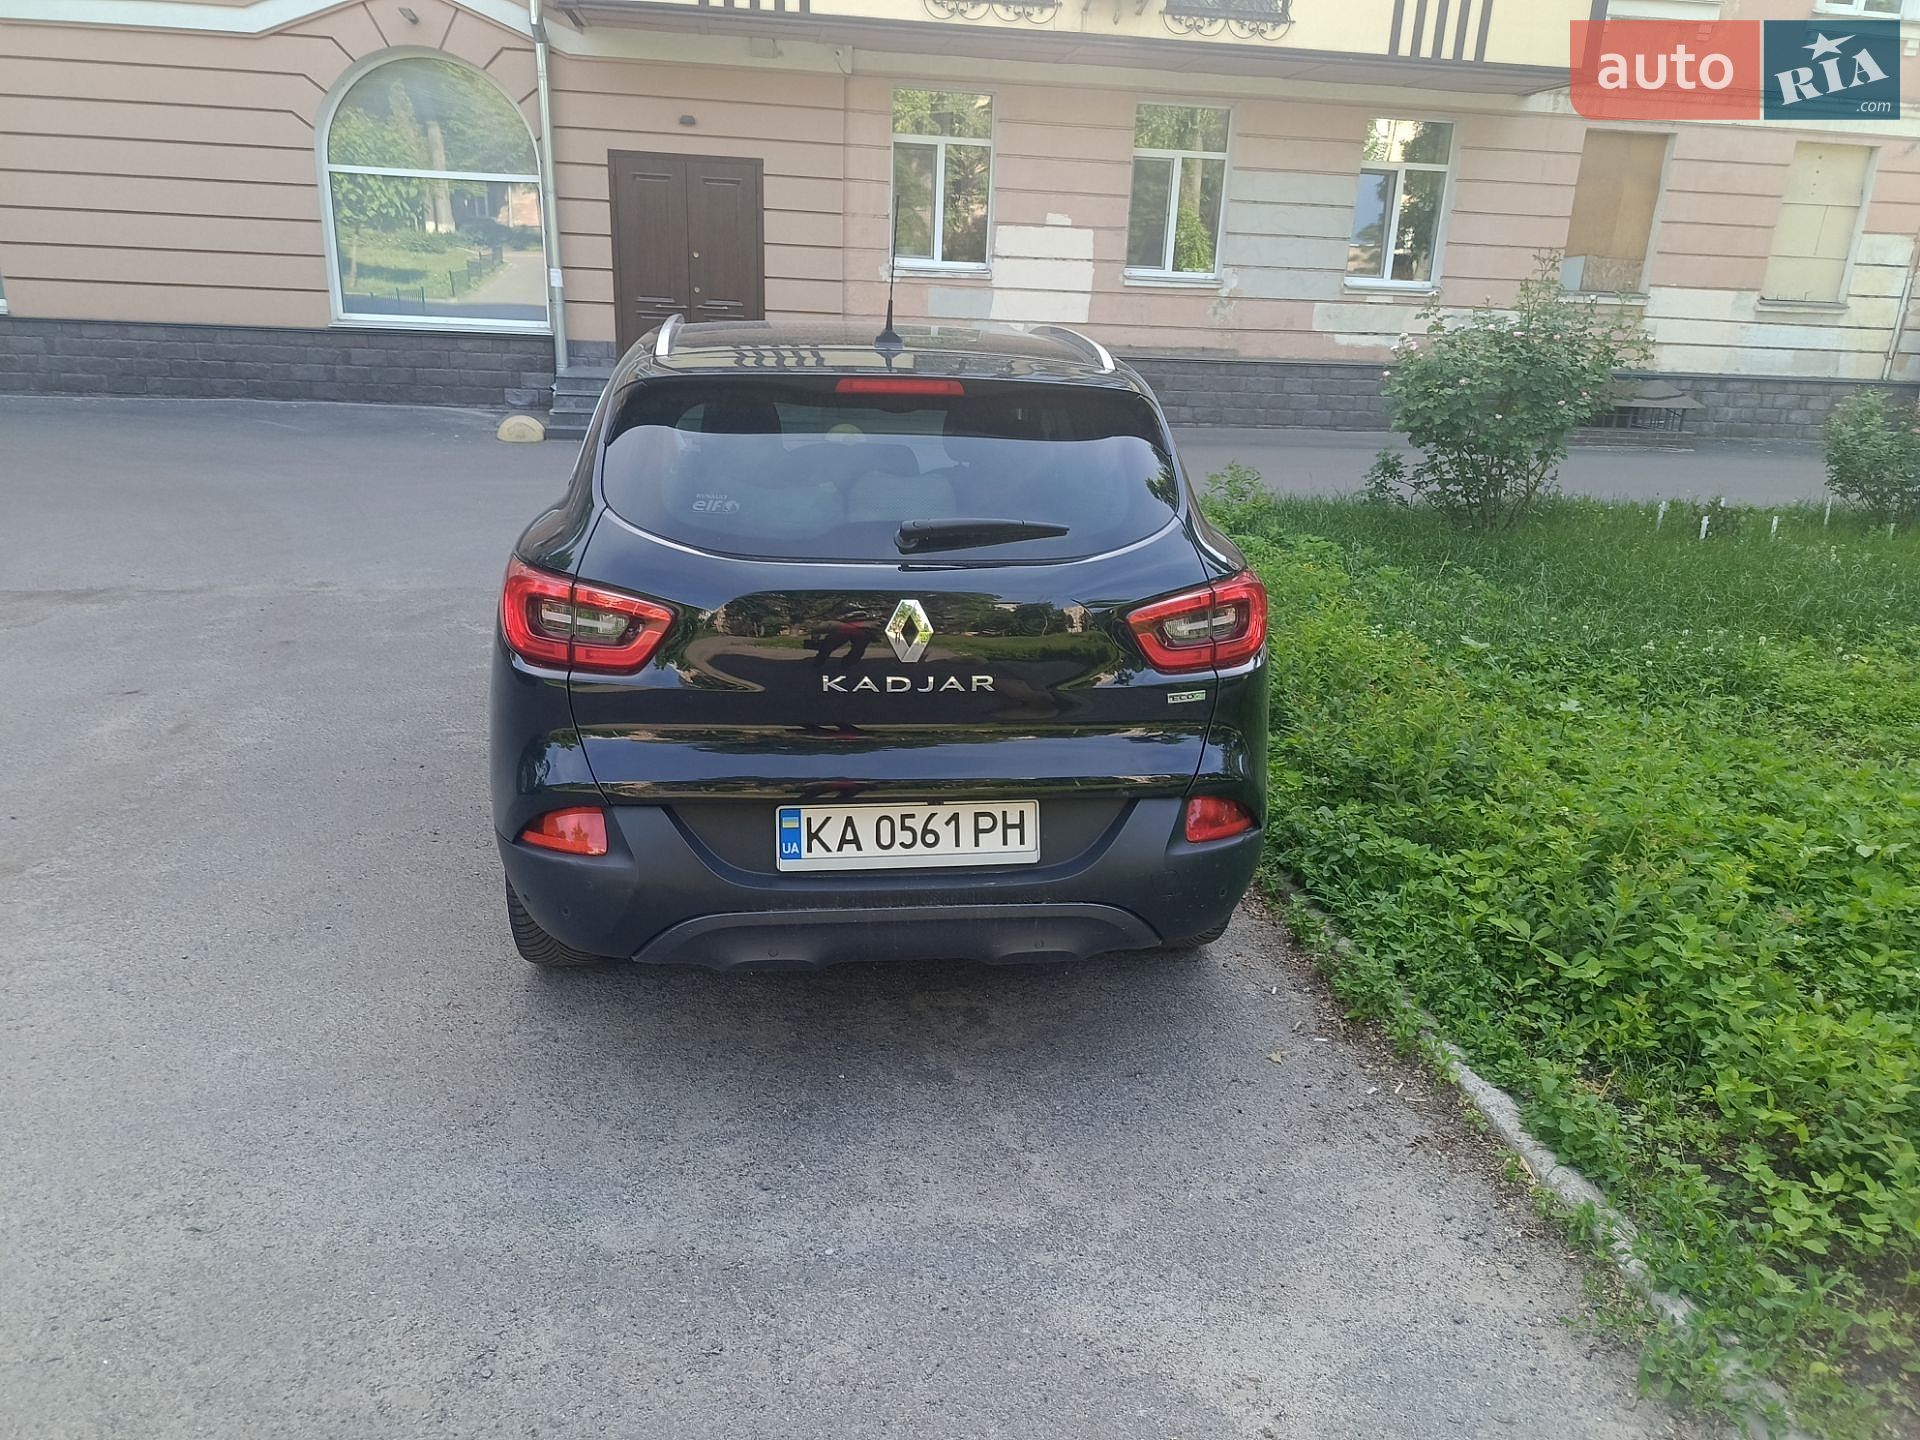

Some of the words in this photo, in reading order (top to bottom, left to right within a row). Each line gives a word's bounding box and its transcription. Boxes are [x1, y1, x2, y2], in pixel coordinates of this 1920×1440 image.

[822, 675, 996, 693] KADJAR
[806, 816, 863, 854] KA
[875, 812, 961, 850] 0561
[973, 810, 1025, 848] PH
[783, 842, 799, 854] UA
